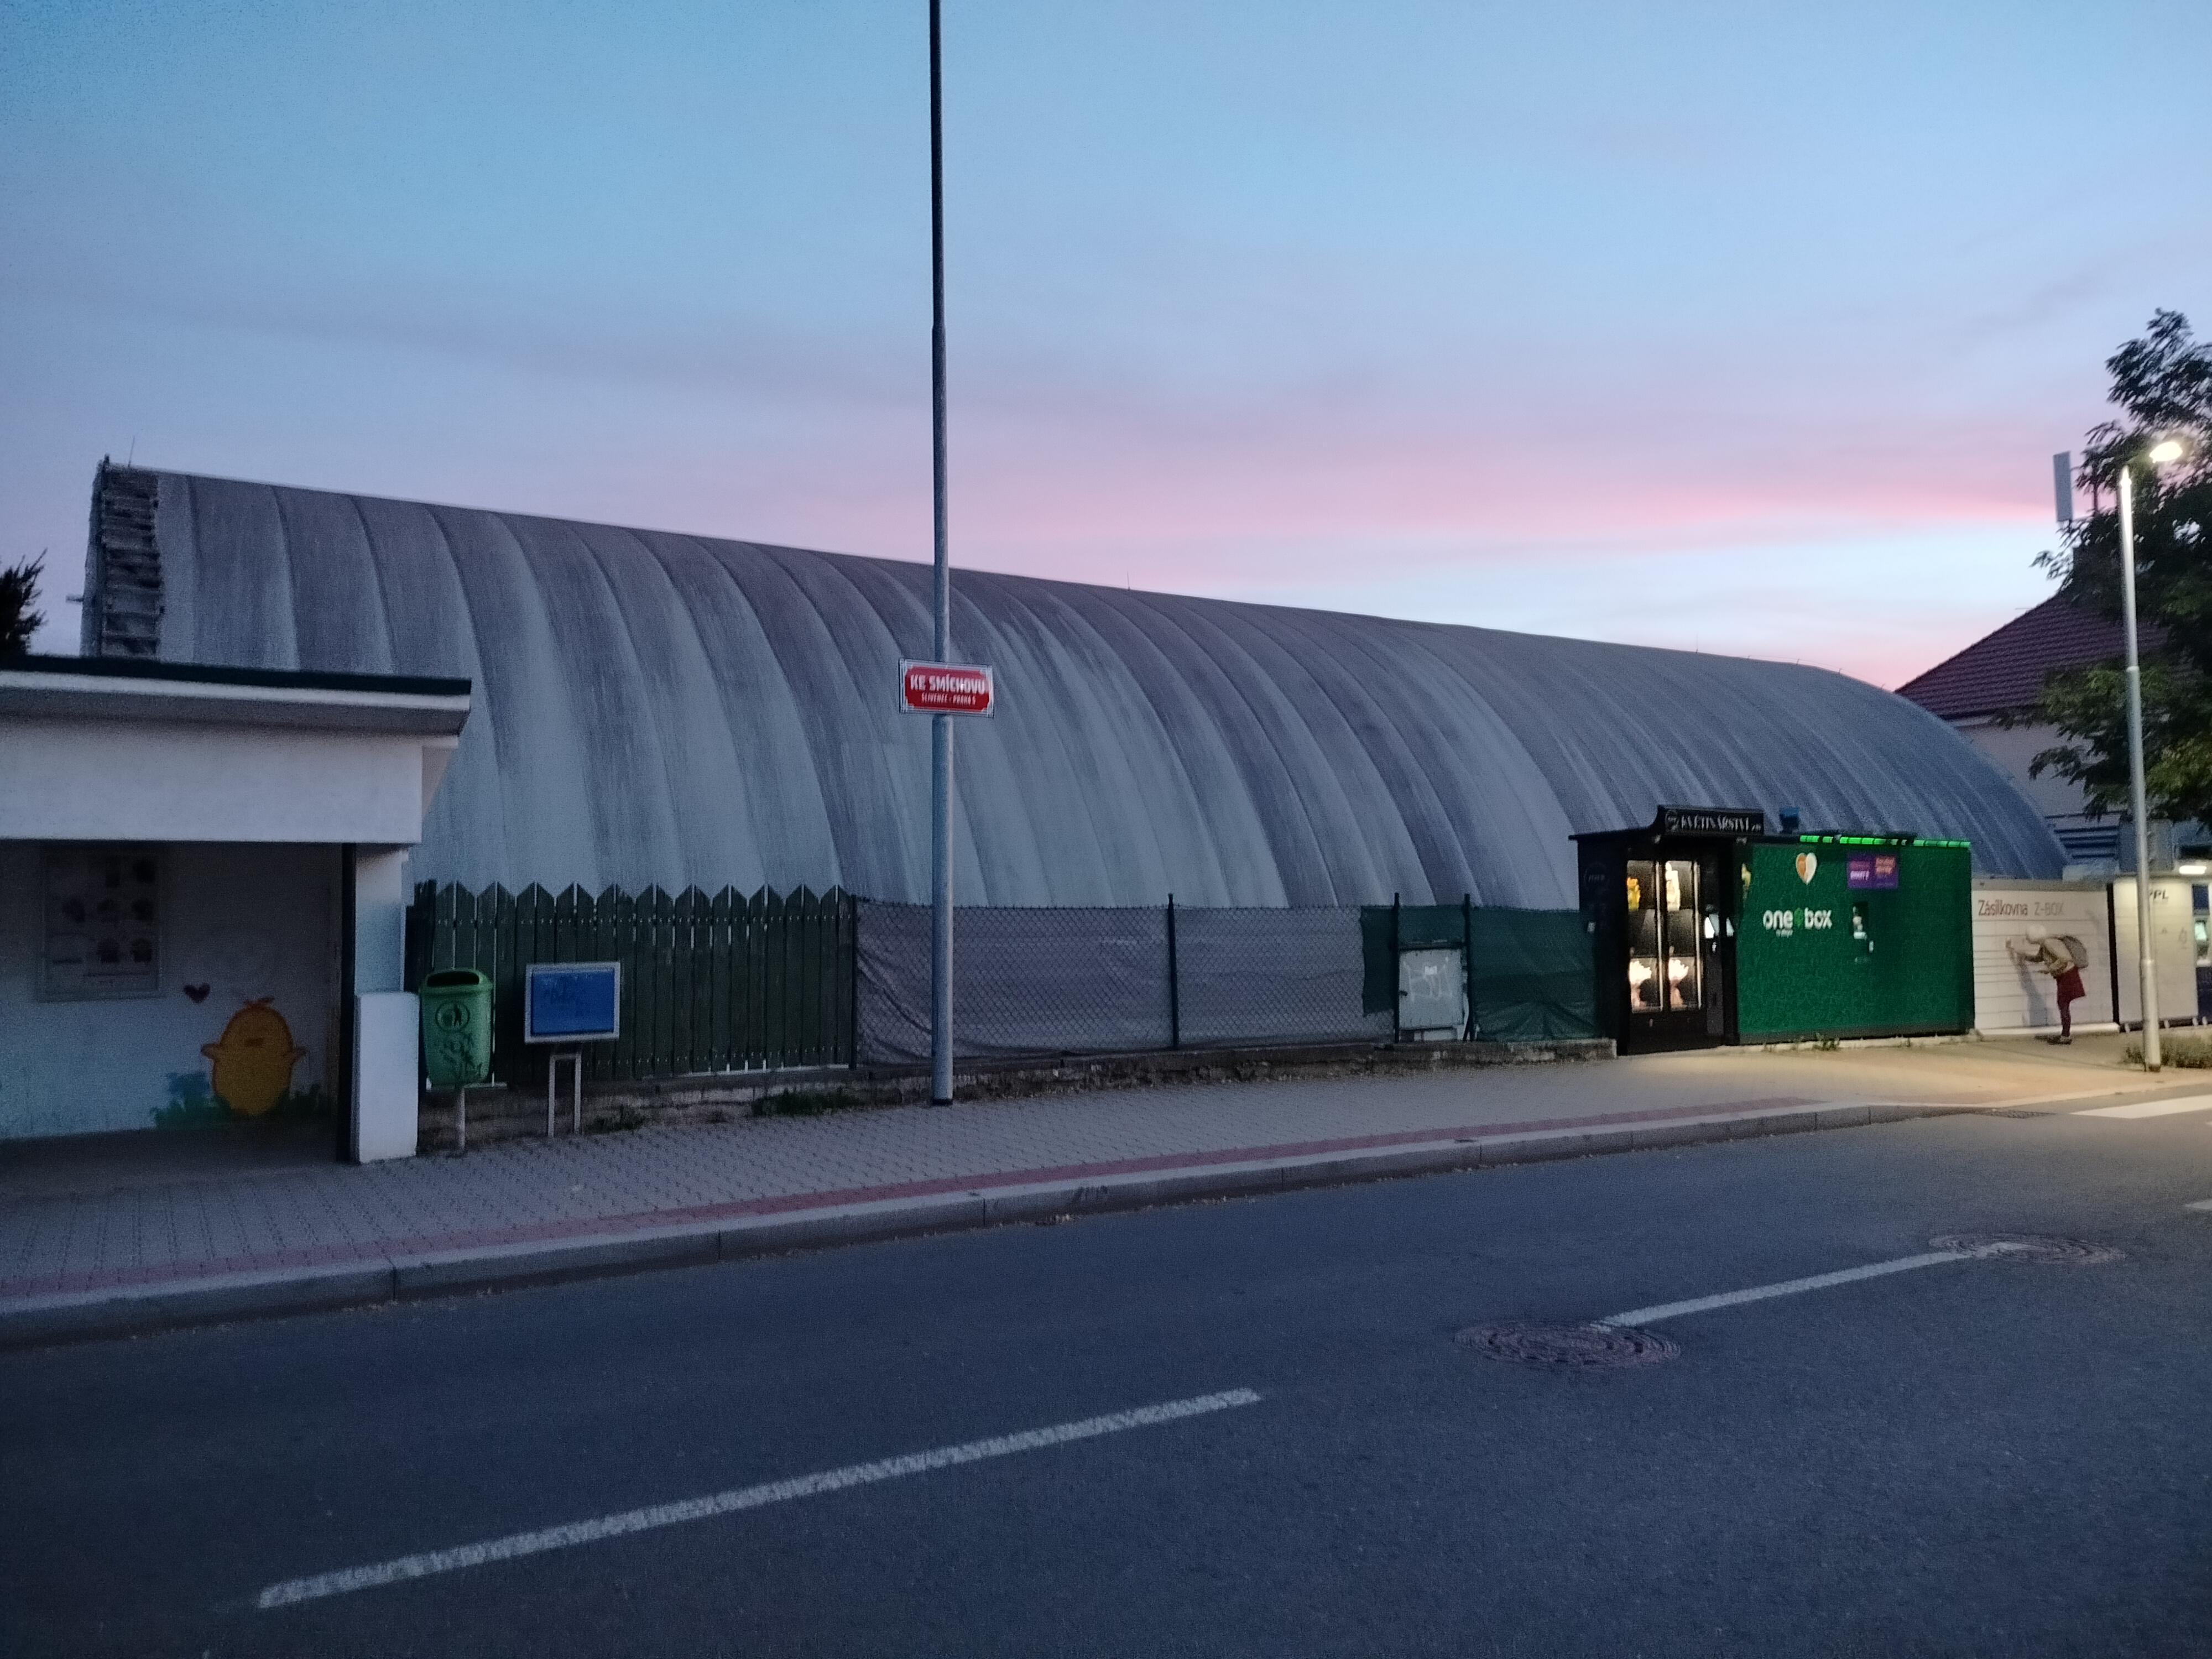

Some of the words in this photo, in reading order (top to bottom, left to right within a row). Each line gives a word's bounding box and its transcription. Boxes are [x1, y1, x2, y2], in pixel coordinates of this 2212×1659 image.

[910, 674, 926, 691] KE
[929, 674, 985, 695] SMÍCHOVU
[953, 693, 972, 706] PRAHA
[1978, 899, 2028, 916] Zásilkovna
[2034, 902, 2065, 916] Z-BOX
[1763, 910, 1793, 930] one
[1804, 907, 1833, 930] box
